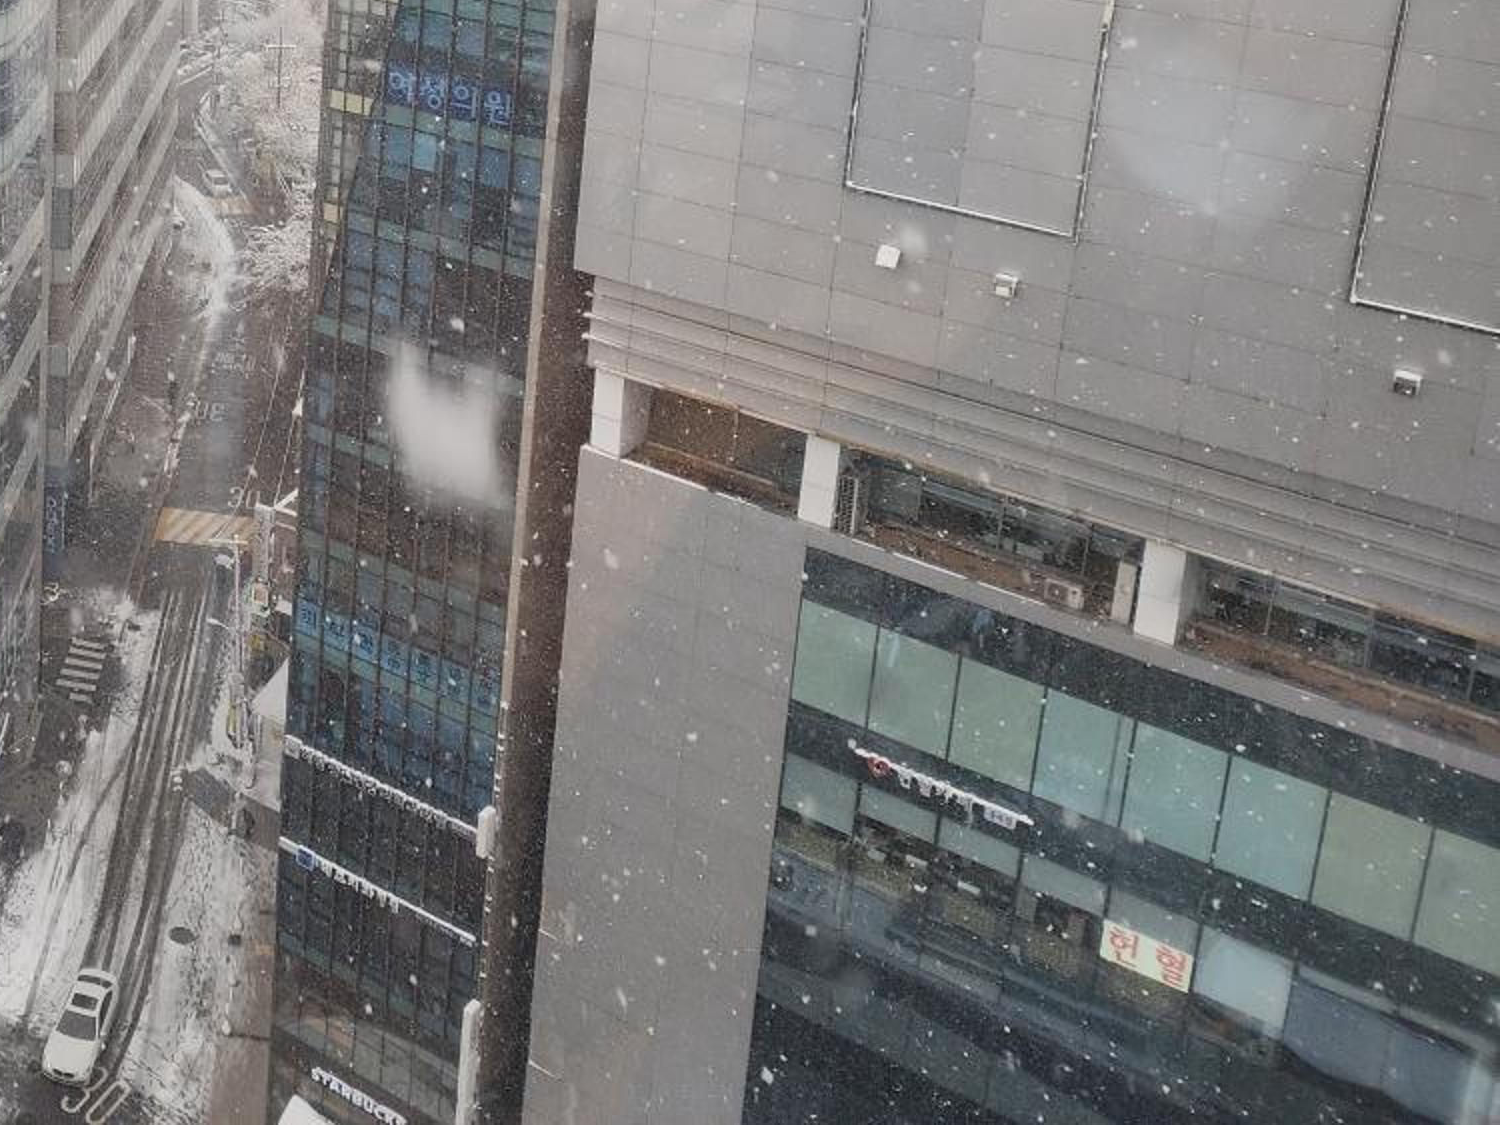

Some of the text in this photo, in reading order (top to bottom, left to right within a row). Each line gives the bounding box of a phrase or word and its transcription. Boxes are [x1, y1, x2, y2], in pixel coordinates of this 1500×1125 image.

[388, 71, 511, 126] 여성의원
[1109, 925, 1186, 988] 헌혈
[61, 1066, 132, 1125] 30
